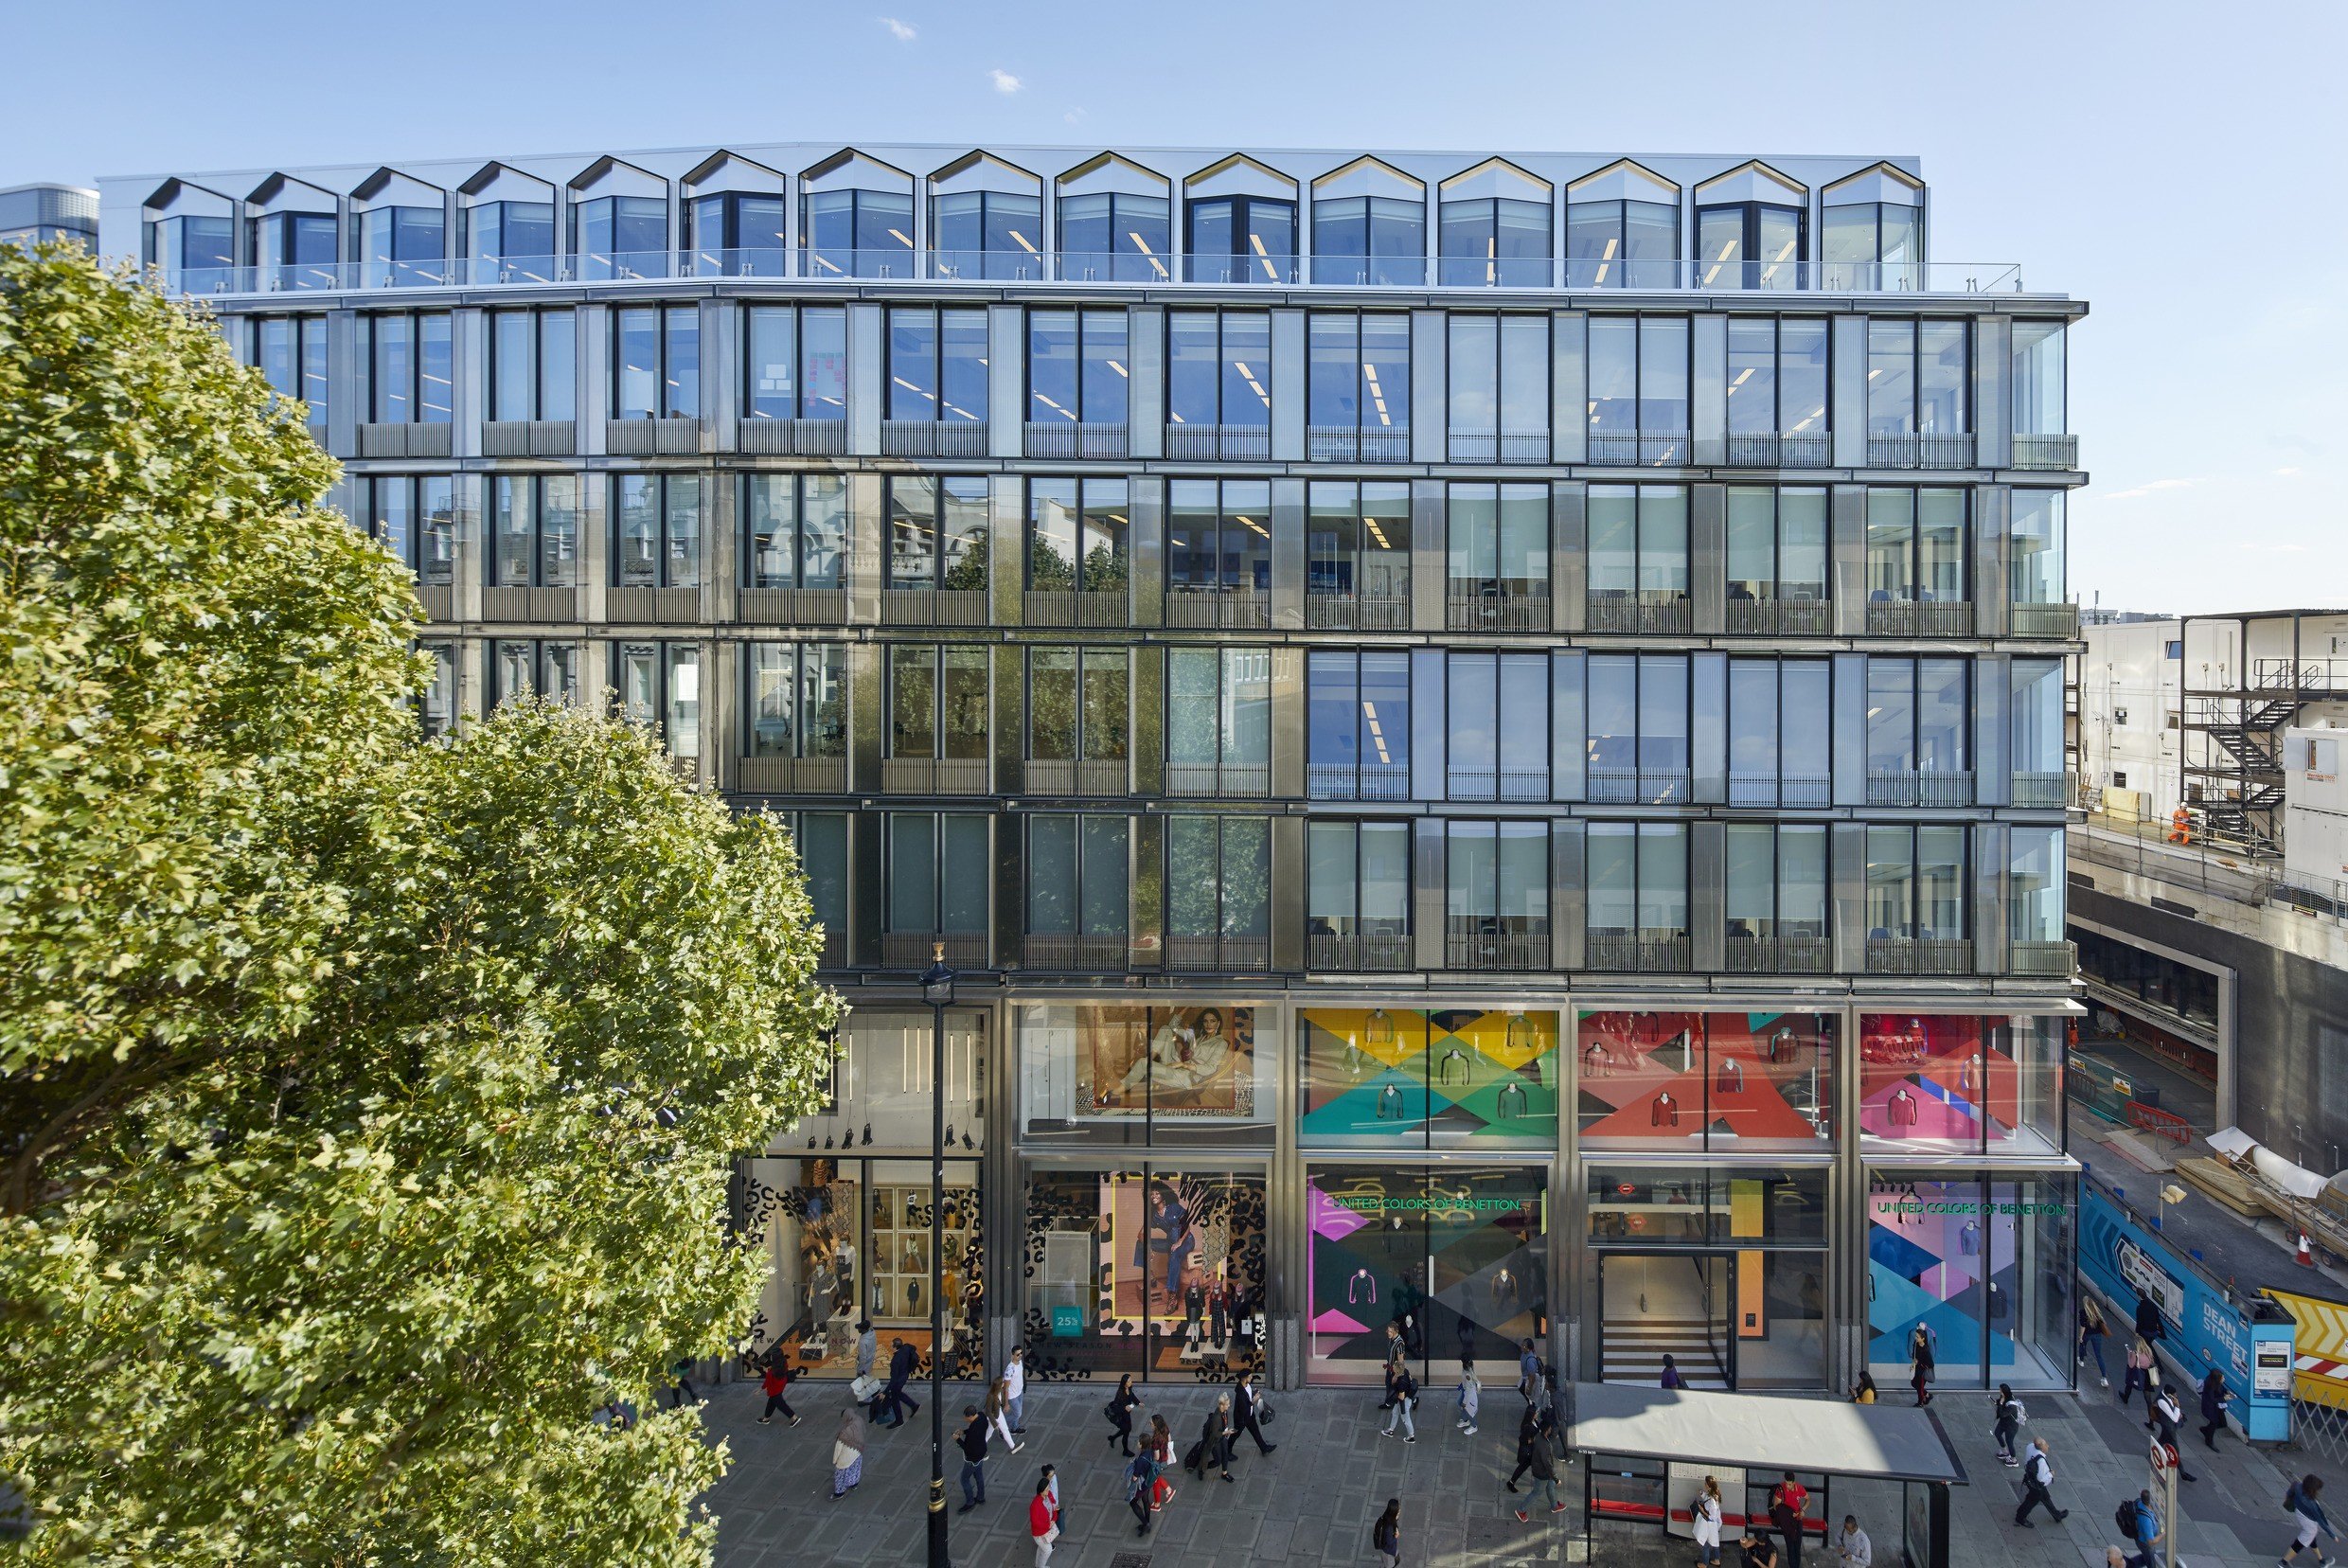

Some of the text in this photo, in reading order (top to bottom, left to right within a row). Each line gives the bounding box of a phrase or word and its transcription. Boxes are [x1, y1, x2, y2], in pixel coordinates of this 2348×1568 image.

[1332, 1198, 1379, 1209] UNITED
[1382, 1199, 1432, 1209] COLORS
[1434, 1199, 1452, 1210] OF
[1877, 1203, 1924, 1215] UNITED
[1926, 1203, 1977, 1215] COLORS
[1980, 1203, 1998, 1215] OF
[2203, 1302, 2236, 1339] DEAN
[2203, 1316, 2248, 1361] STREET
